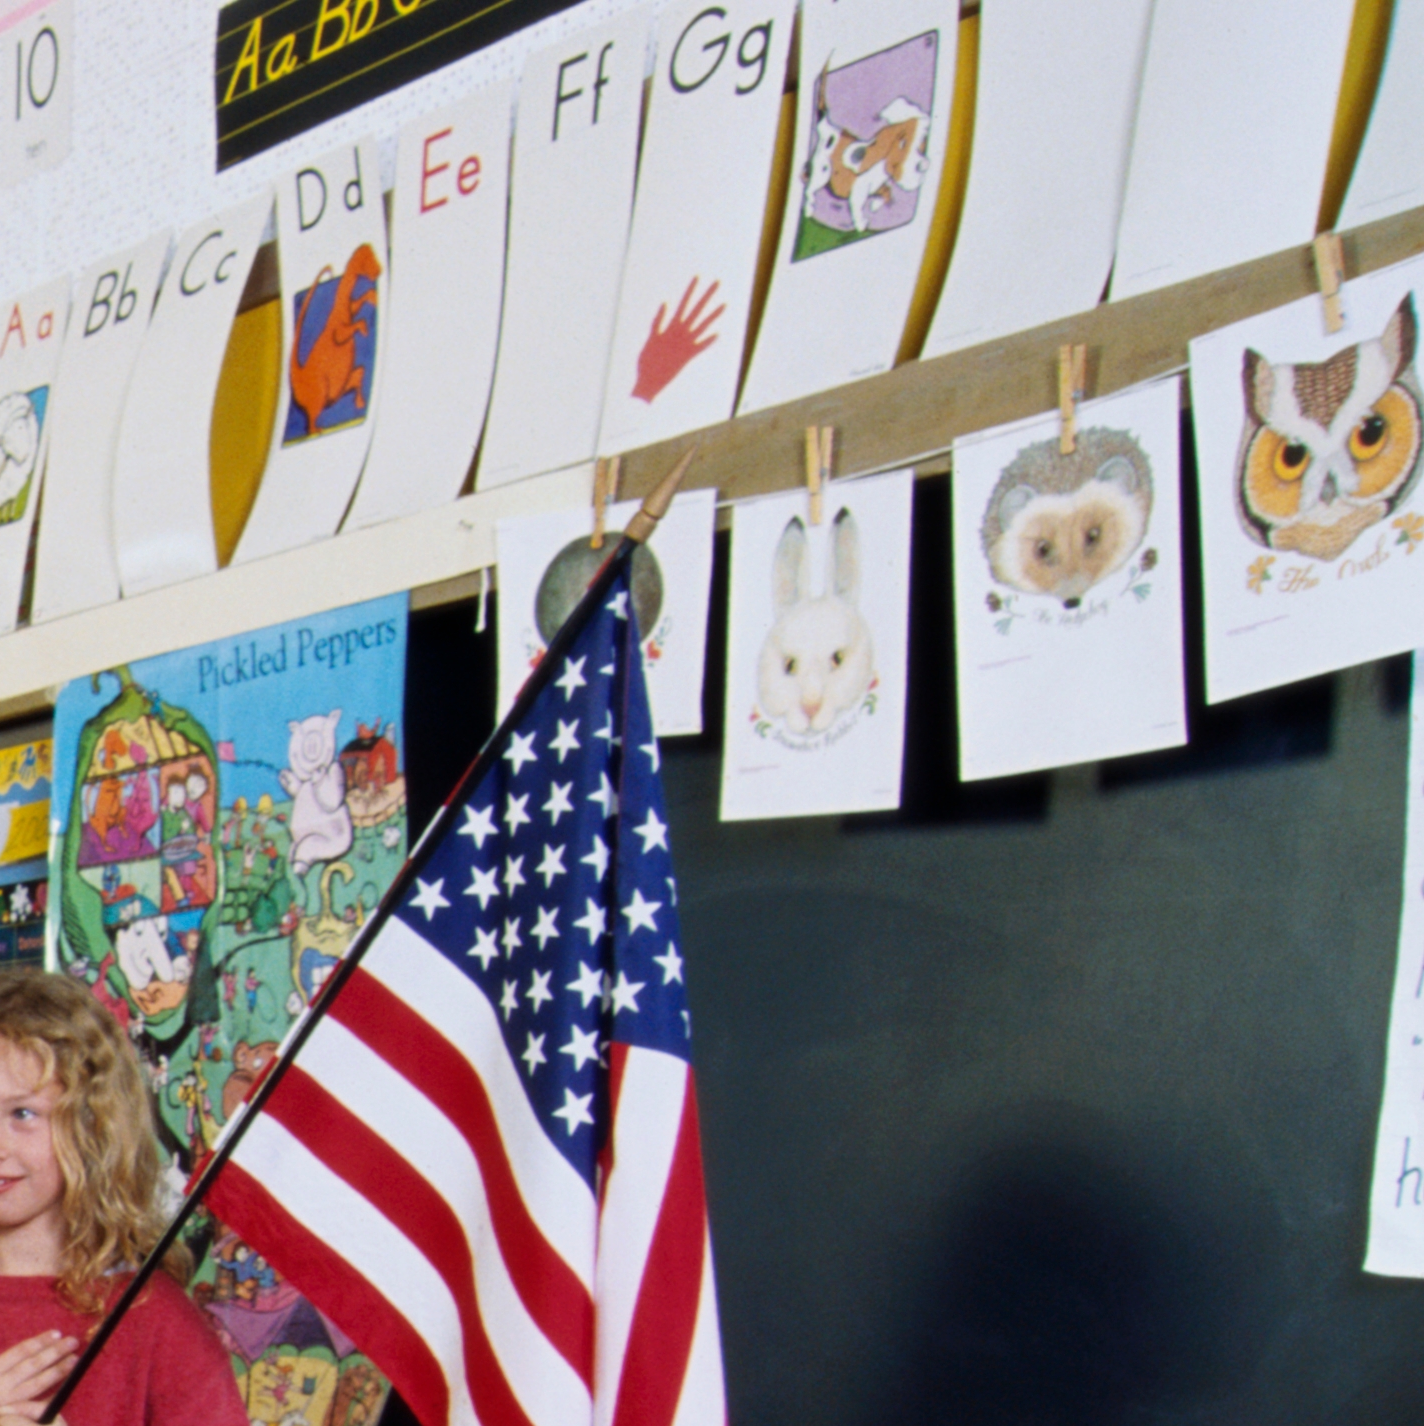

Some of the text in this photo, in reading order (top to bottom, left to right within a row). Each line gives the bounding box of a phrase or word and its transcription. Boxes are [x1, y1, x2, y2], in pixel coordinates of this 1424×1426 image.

[14, 26, 59, 122] 10
[551, 40, 614, 142] Ff
[667, 5, 774, 96] Gg
[418, 128, 481, 214] Ee
[82, 261, 138, 338] Bb
[178, 230, 237, 298] Cc
[197, 615, 397, 694] Pickled Peppers
